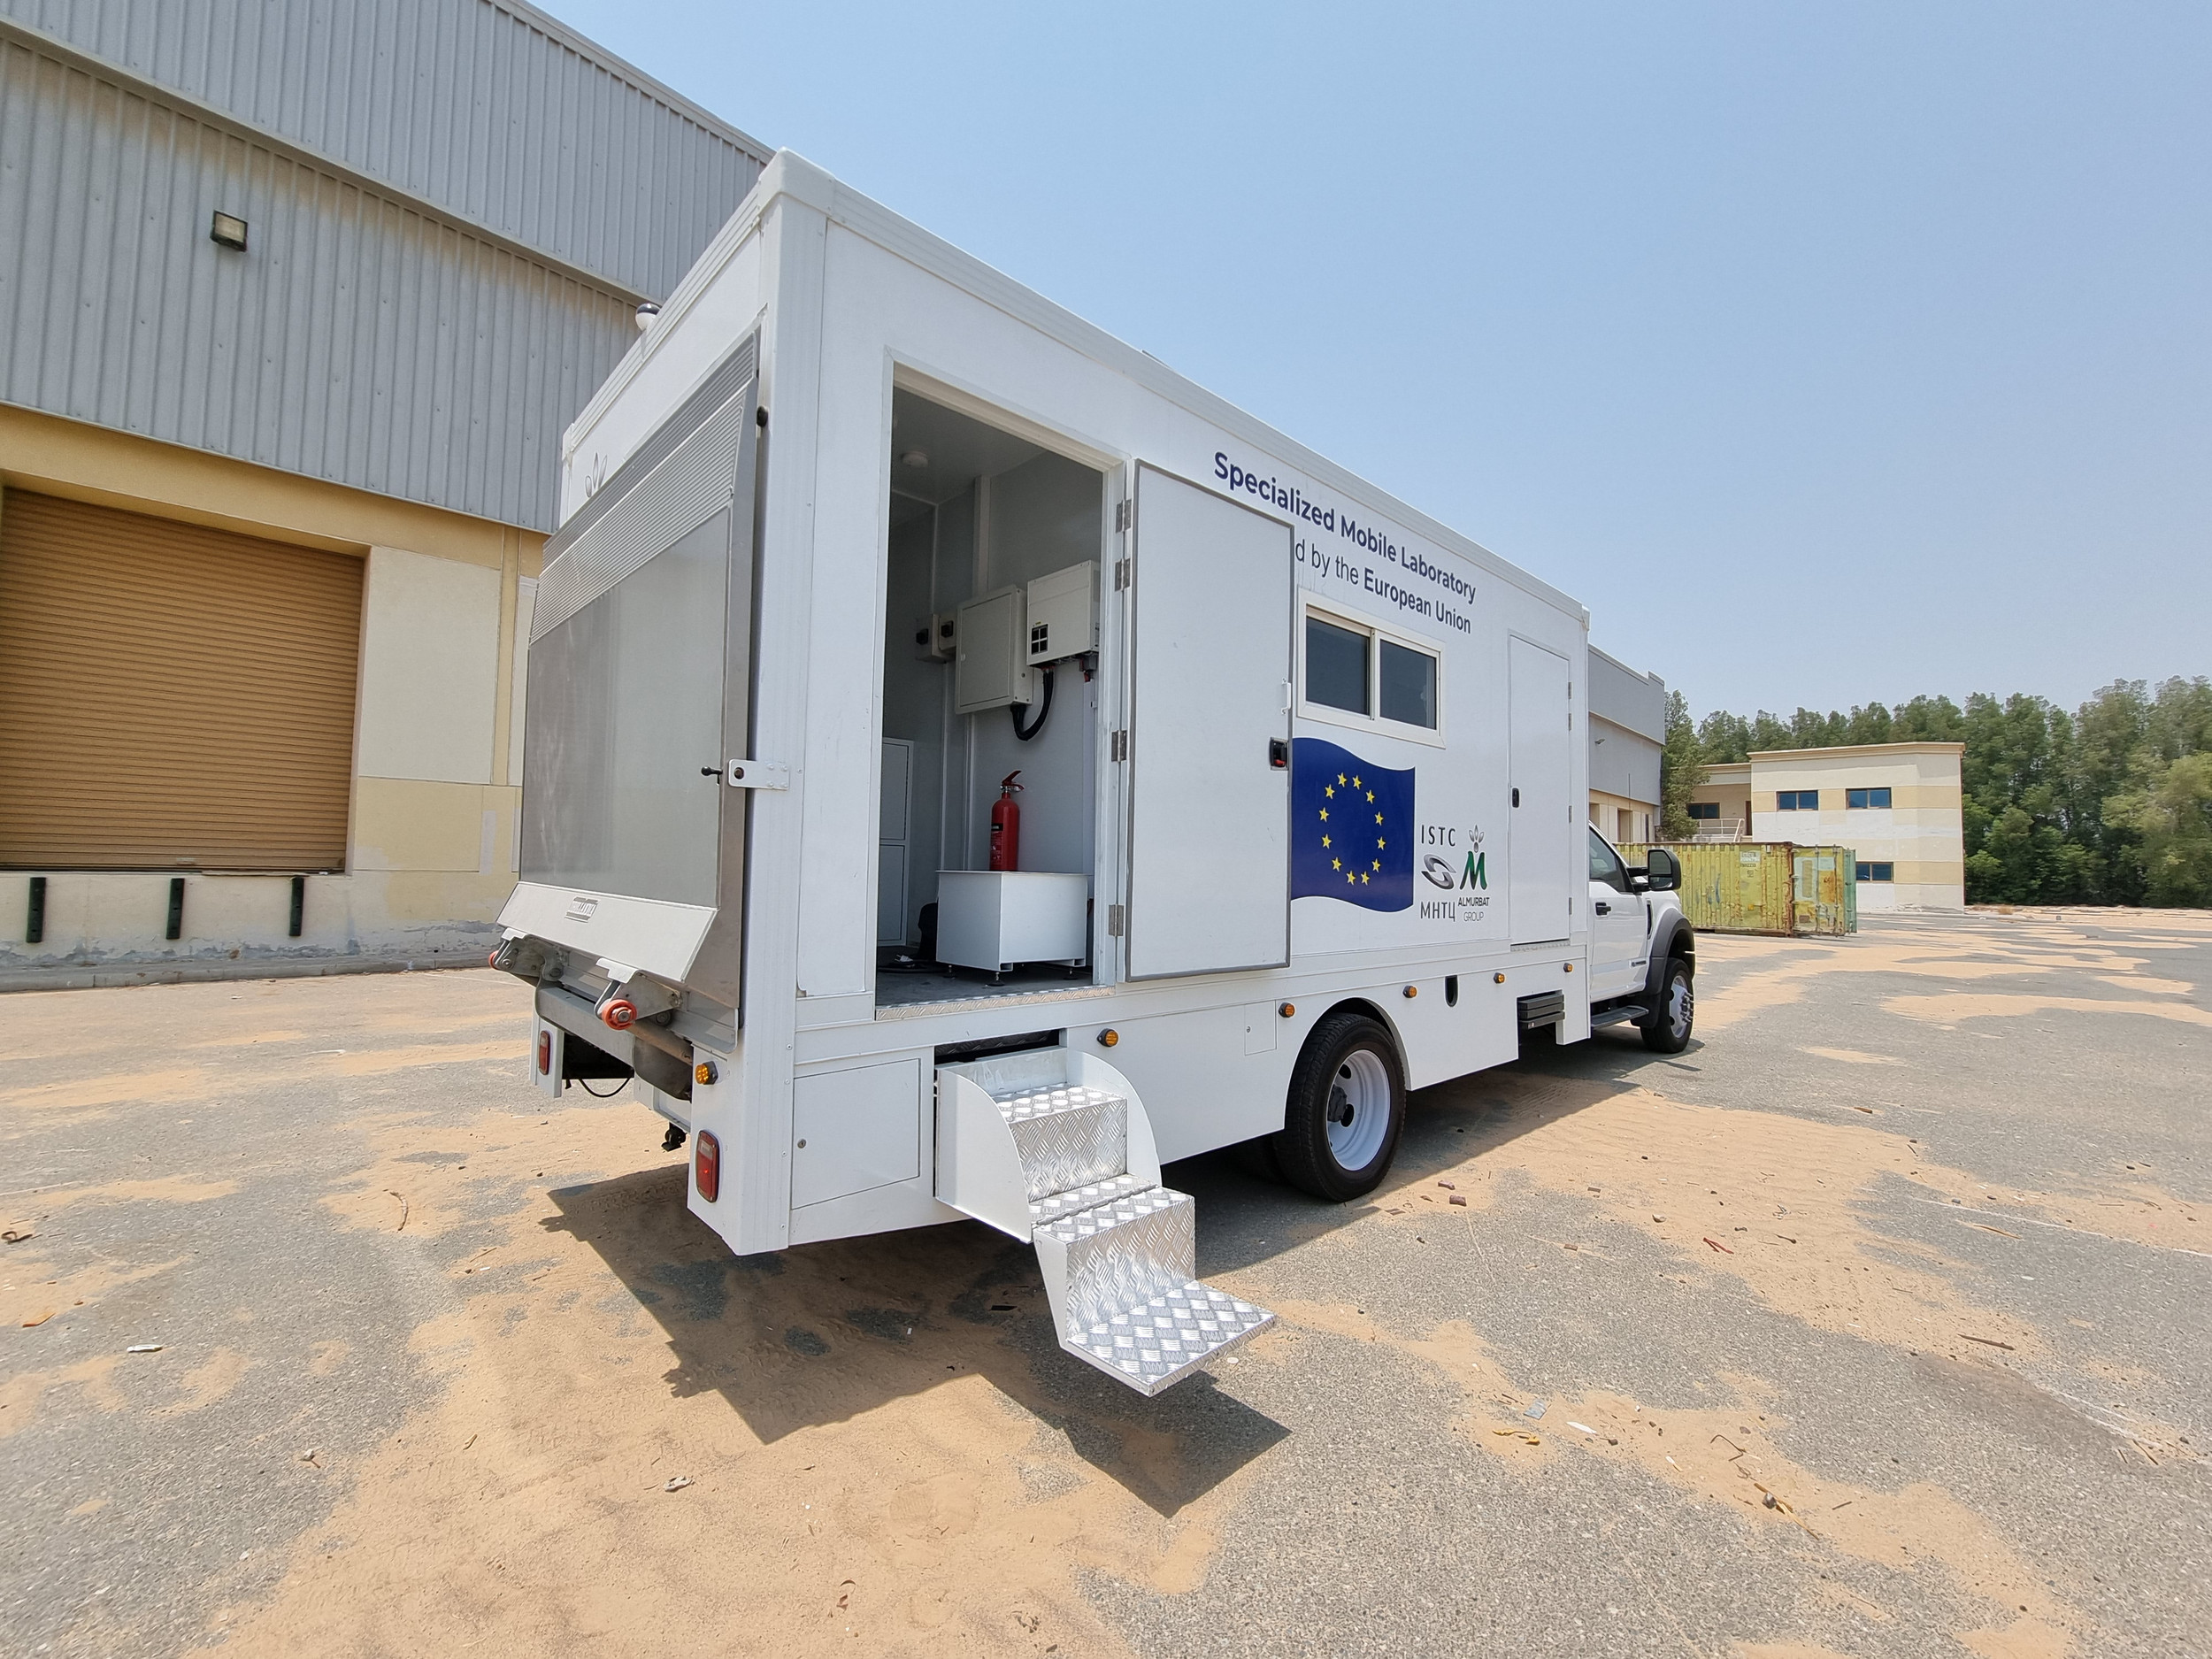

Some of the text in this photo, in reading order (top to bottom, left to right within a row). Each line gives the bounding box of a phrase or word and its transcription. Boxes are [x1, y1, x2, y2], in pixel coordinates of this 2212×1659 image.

[1214, 451, 1334, 533] Specialized
[1340, 515, 1396, 562] Mobile
[1401, 546, 1477, 604] Laboratory
[1311, 542, 1331, 578] by
[1335, 555, 1359, 585] the
[1364, 567, 1432, 617] European
[1435, 600, 1471, 634] Union
[1421, 824, 1456, 847] ISTC
[1457, 896, 1490, 907] ALMURBAT
[1463, 911, 1485, 922] GROUP
